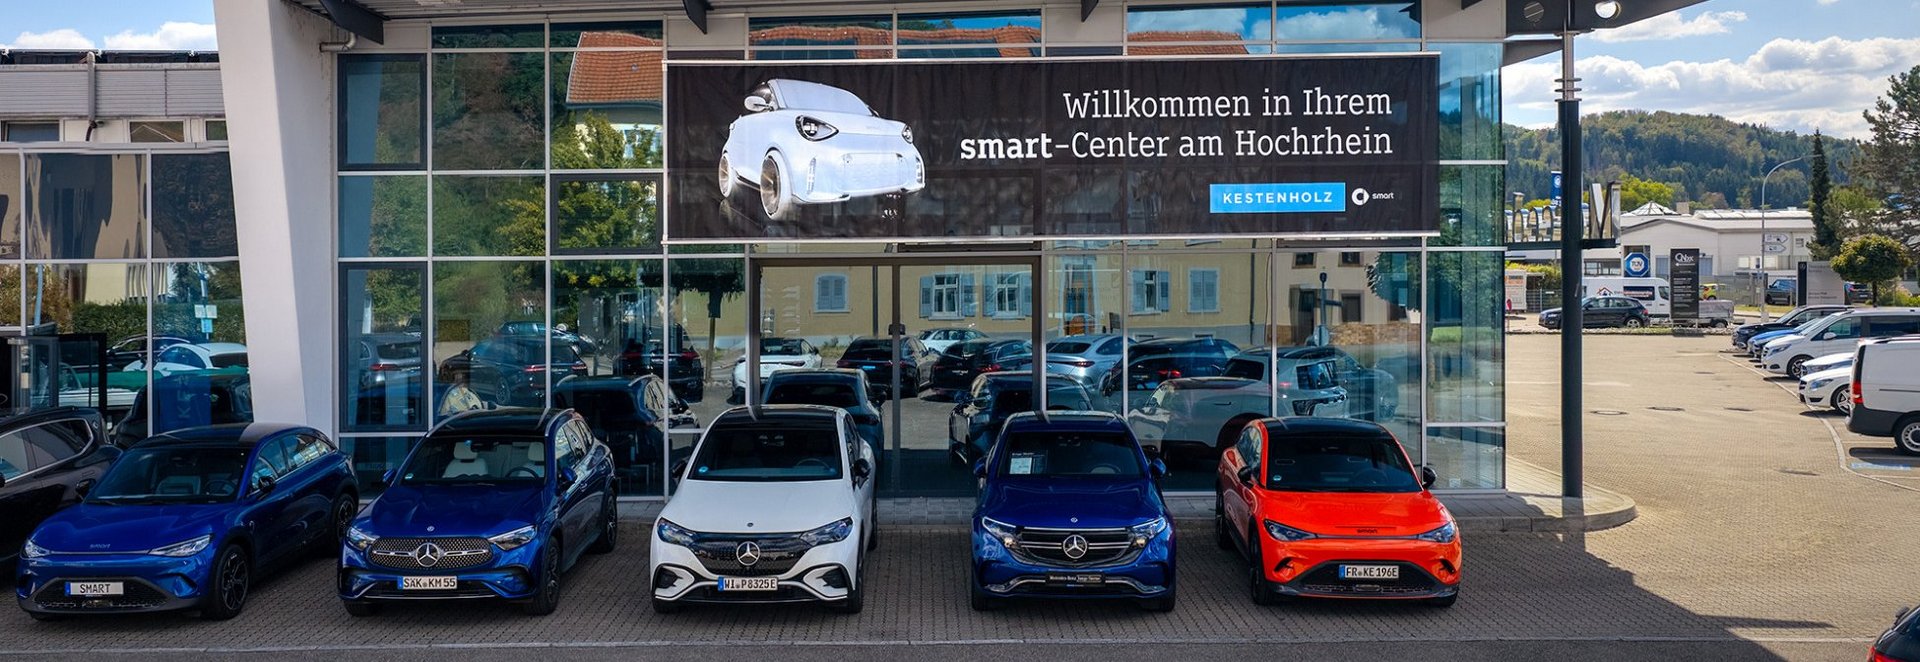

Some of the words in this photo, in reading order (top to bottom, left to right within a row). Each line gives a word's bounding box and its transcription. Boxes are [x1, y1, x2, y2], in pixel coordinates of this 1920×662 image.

[1062, 89, 1251, 119] Willkommen
[1262, 88, 1292, 117] in
[1303, 87, 1393, 116] Ihrem
[960, 131, 1170, 160] smart-Center
[1179, 136, 1224, 157] am
[1235, 126, 1393, 156] Hochrhein
[1222, 191, 1333, 204] KESTENHOLZ
[1372, 191, 1394, 200] smart
[1346, 566, 1358, 577] FR
[403, 577, 422, 588] SÄK
[79, 583, 111, 594] SMART
